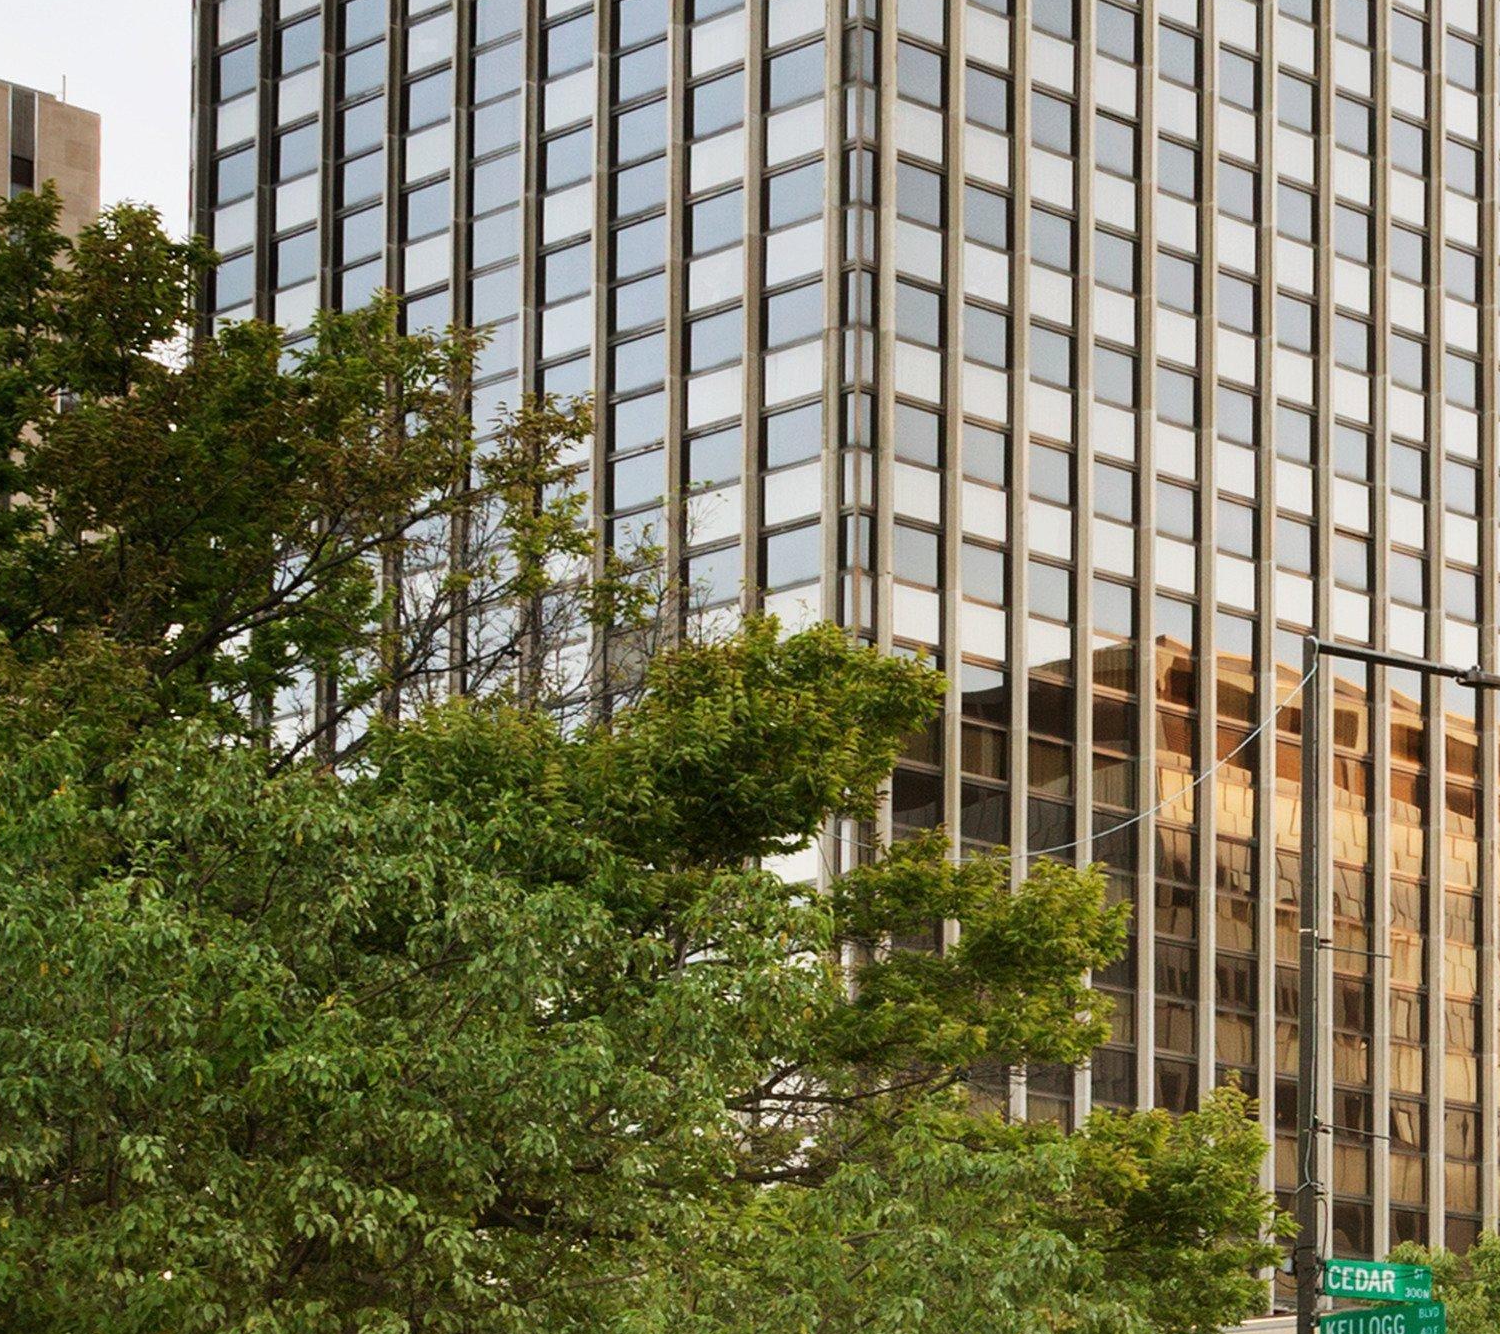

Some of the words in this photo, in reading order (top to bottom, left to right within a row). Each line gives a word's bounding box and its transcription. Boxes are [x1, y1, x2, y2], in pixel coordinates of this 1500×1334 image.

[1328, 1266, 1396, 1294] CEDAR
[1414, 1269, 1424, 1280] ST
[1418, 1307, 1440, 1319] BLVD
